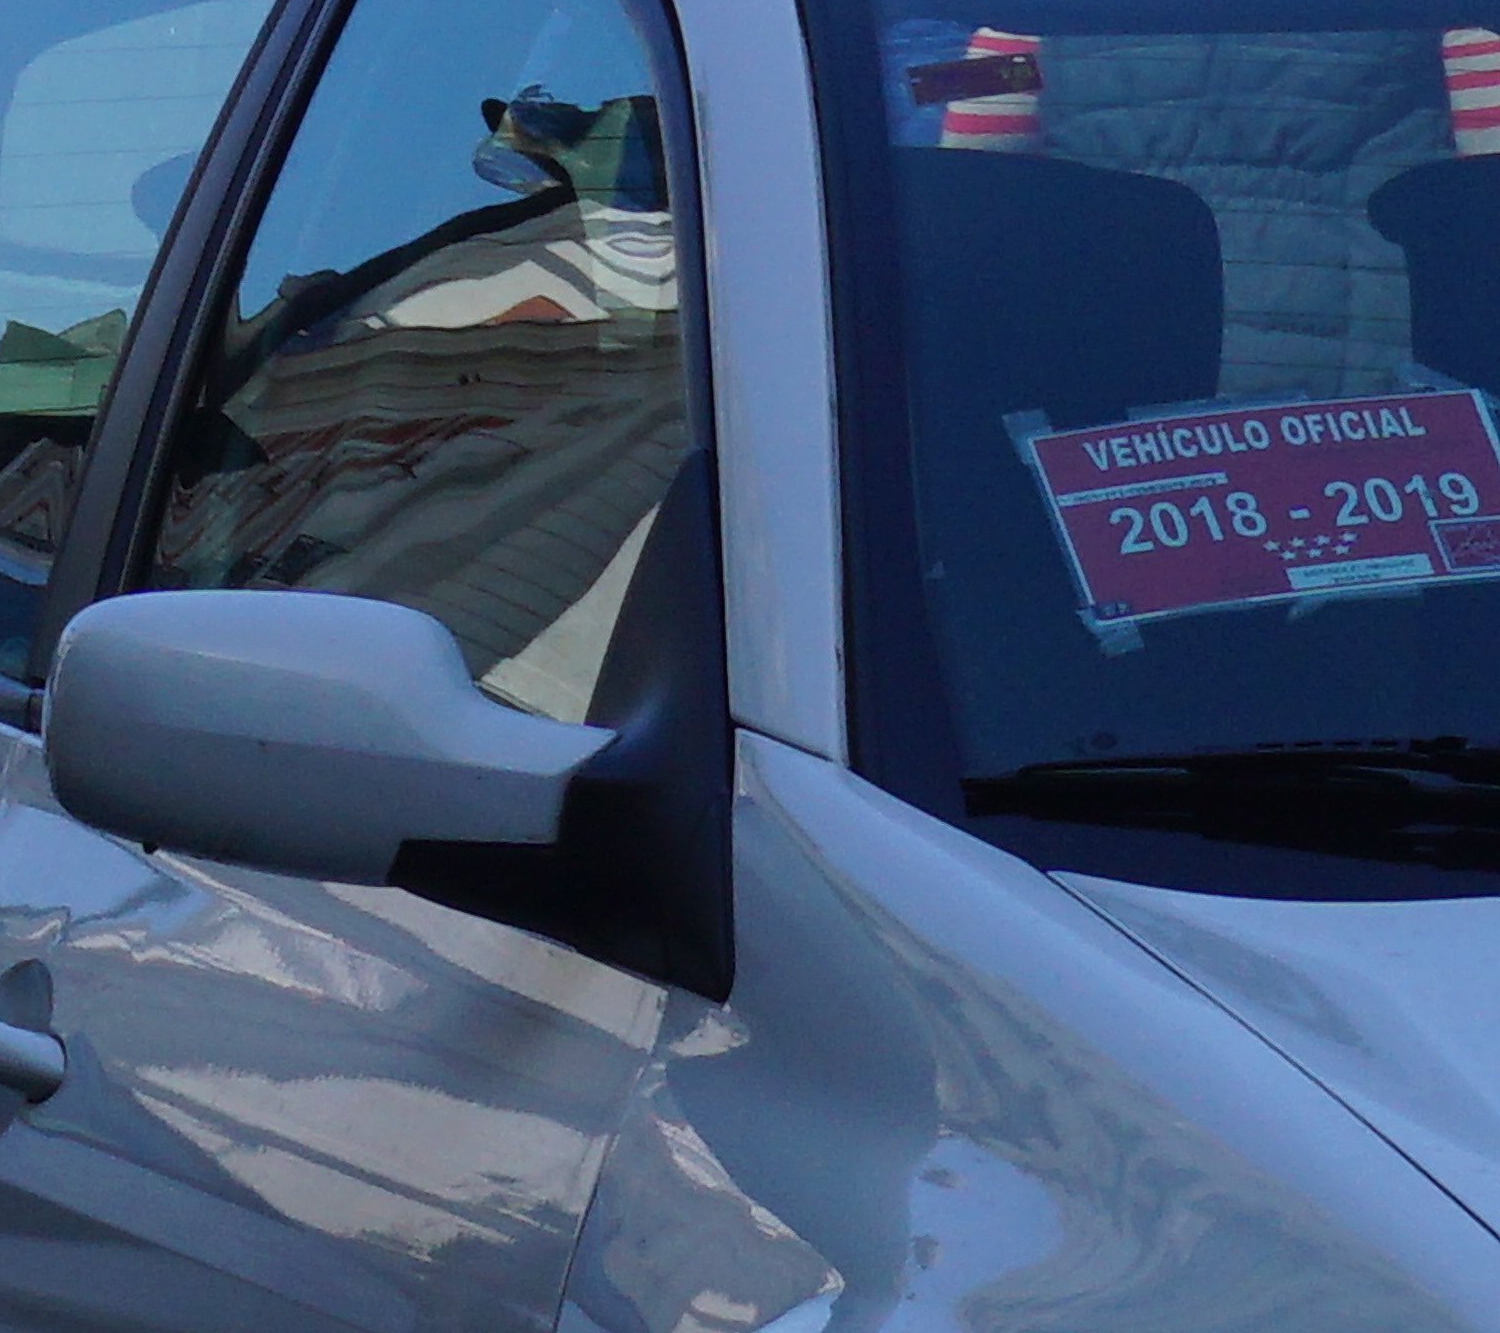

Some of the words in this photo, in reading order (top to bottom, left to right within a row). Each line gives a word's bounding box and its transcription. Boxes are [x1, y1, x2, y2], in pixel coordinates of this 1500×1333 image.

[1082, 419, 1271, 472] VEHÍCULO
[1279, 406, 1428, 447] OFICIAL
[1108, 491, 1269, 556] 2018
[1323, 471, 1480, 527] 2019
